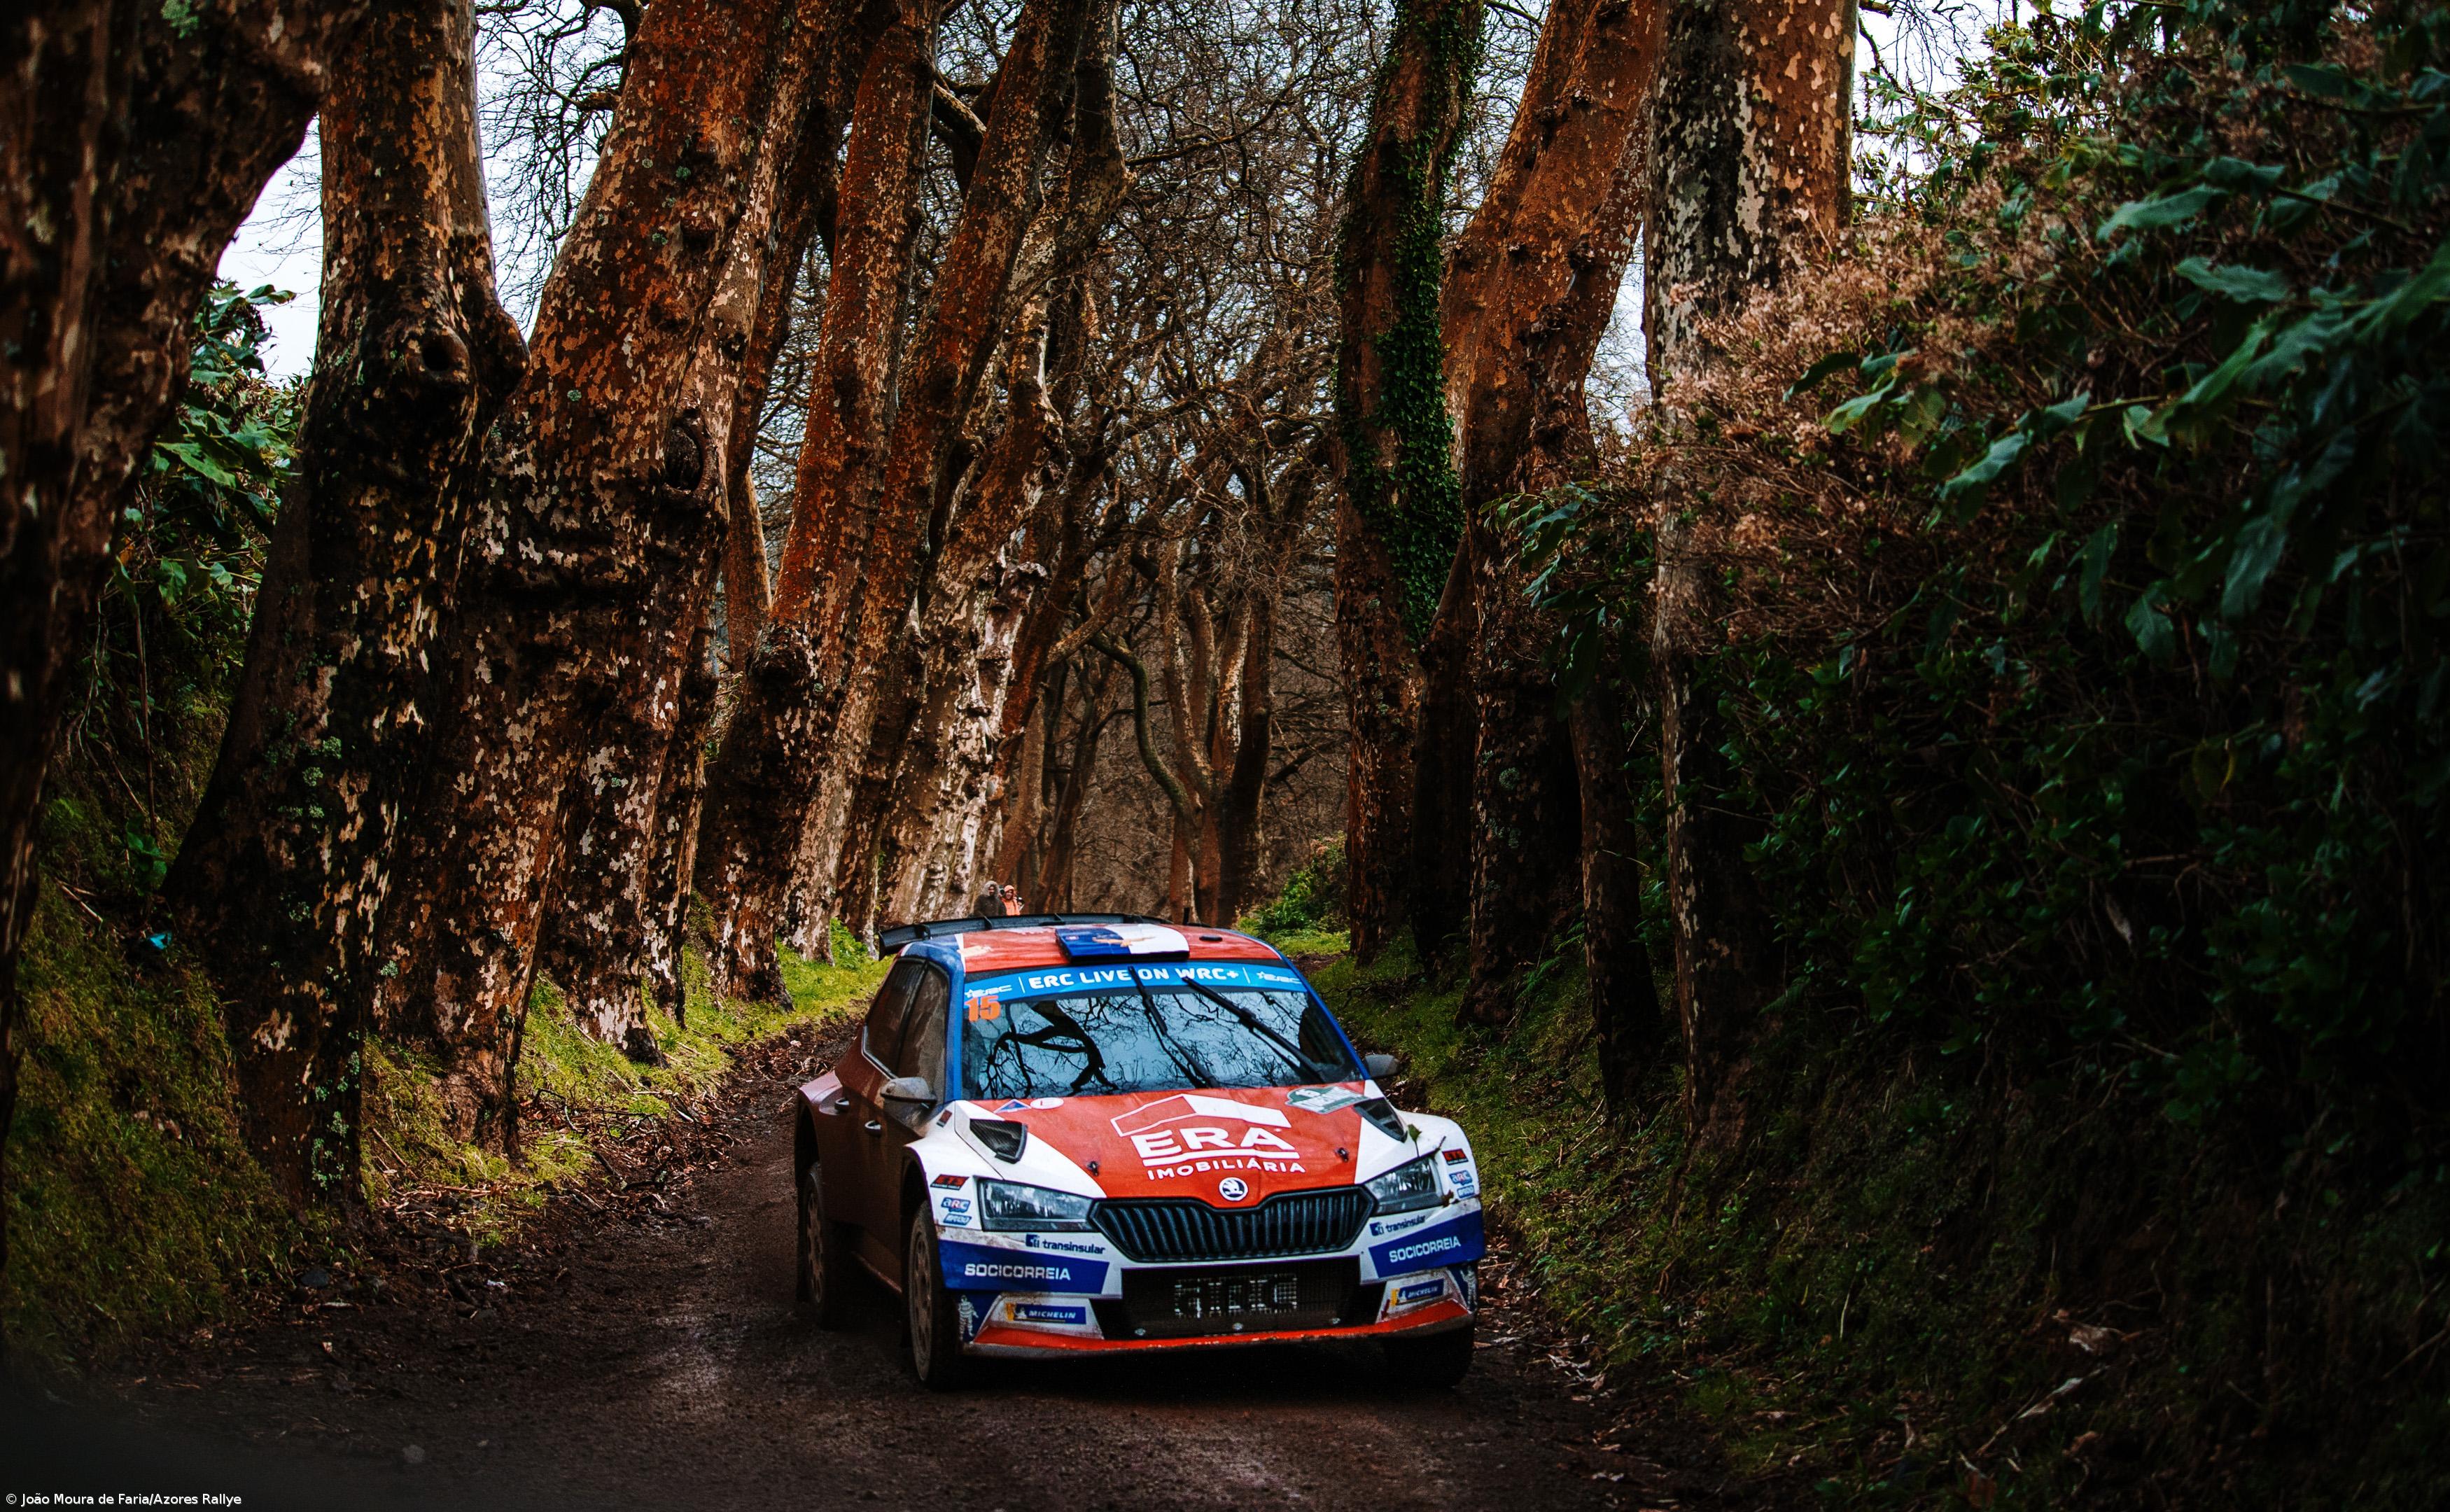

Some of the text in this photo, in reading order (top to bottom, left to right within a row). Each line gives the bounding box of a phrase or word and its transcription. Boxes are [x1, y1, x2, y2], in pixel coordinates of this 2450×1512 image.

[1028, 967, 1239, 989] ERC LIVE ON WRC+
[963, 995, 1001, 1023] 15
[1130, 1126, 1296, 1158] ERA
[1385, 1214, 1426, 1233] transinsular
[1042, 1238, 1106, 1254] transinsular
[1389, 1236, 1462, 1263] SOCICORREIA
[965, 1263, 1072, 1281] SOCICORREIA
[1028, 1309, 1077, 1320] MICHELIN
